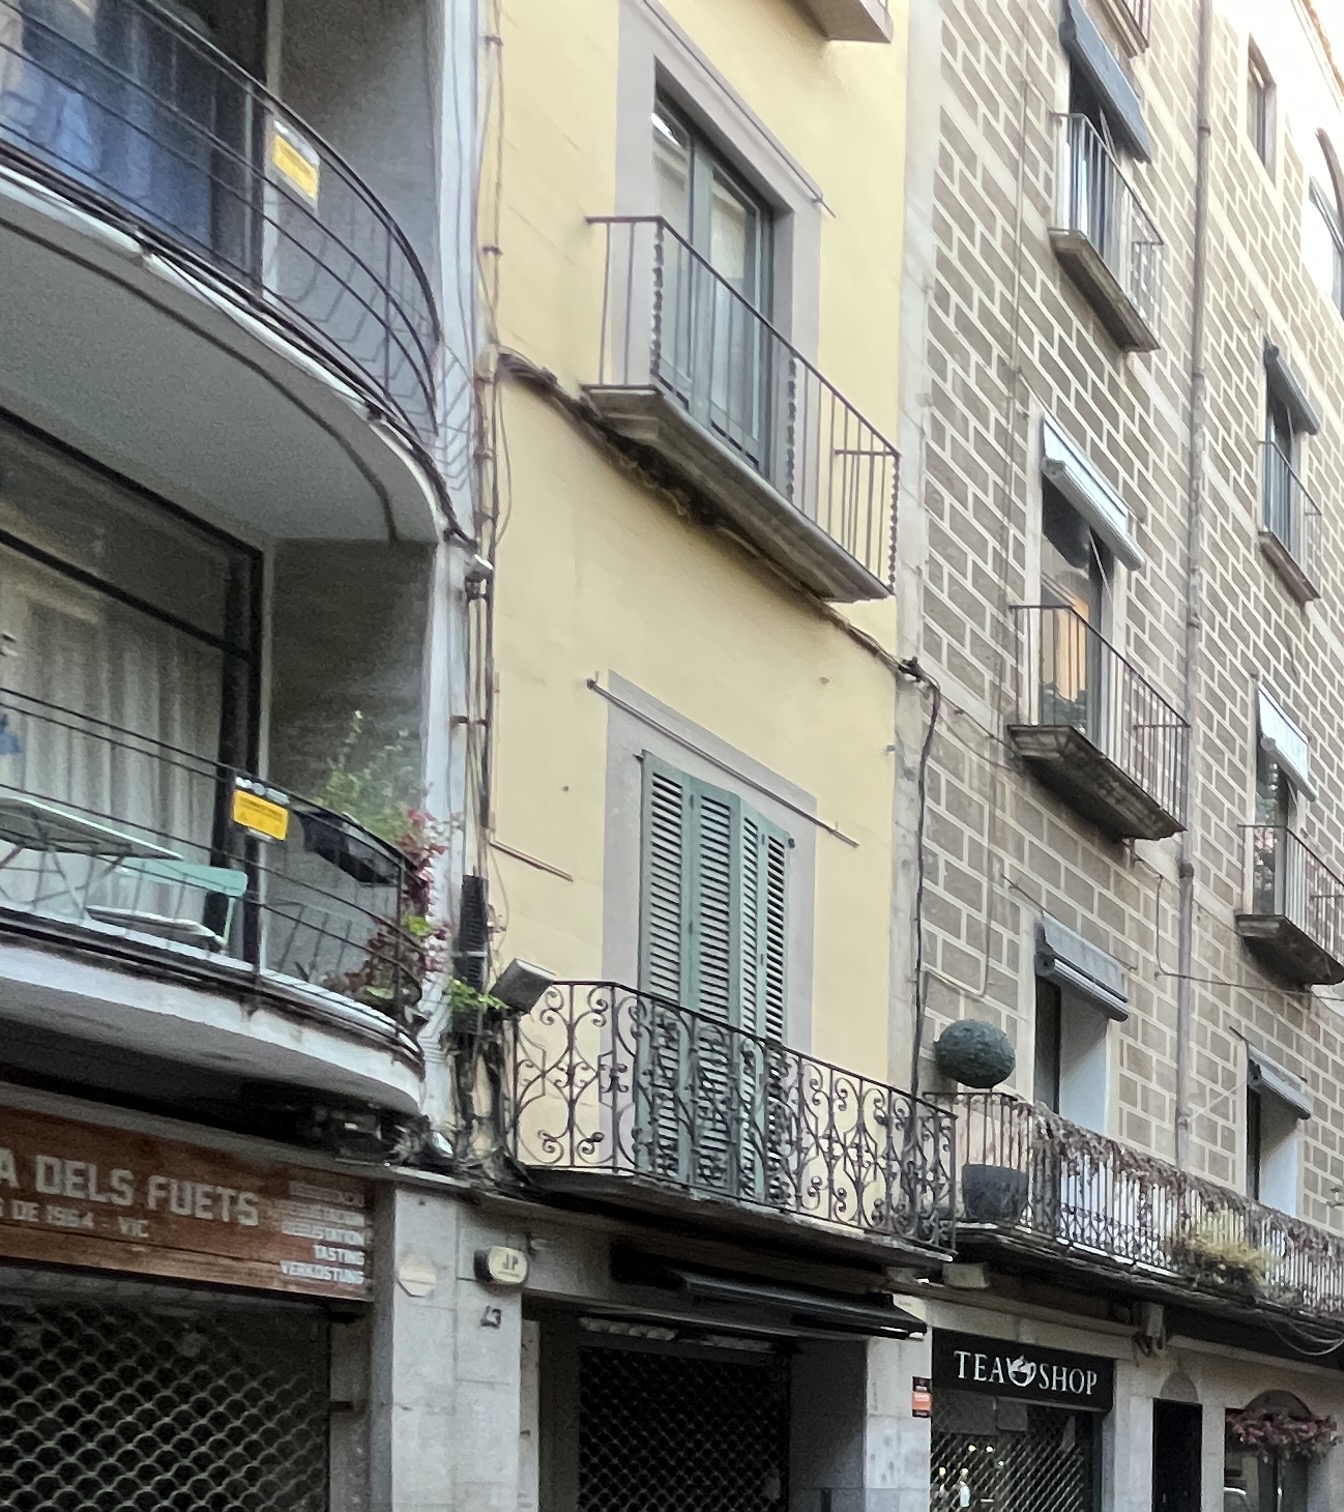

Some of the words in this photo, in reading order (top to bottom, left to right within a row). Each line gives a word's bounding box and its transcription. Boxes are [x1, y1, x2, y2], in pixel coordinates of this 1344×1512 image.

[35, 1154, 135, 1206] DELS
[147, 1174, 260, 1227] FUETS
[10, 1199, 40, 1223] DE
[117, 1215, 149, 1238] VIC
[953, 1350, 1005, 1384] TEA
[1038, 1362, 1098, 1395] SHOP
